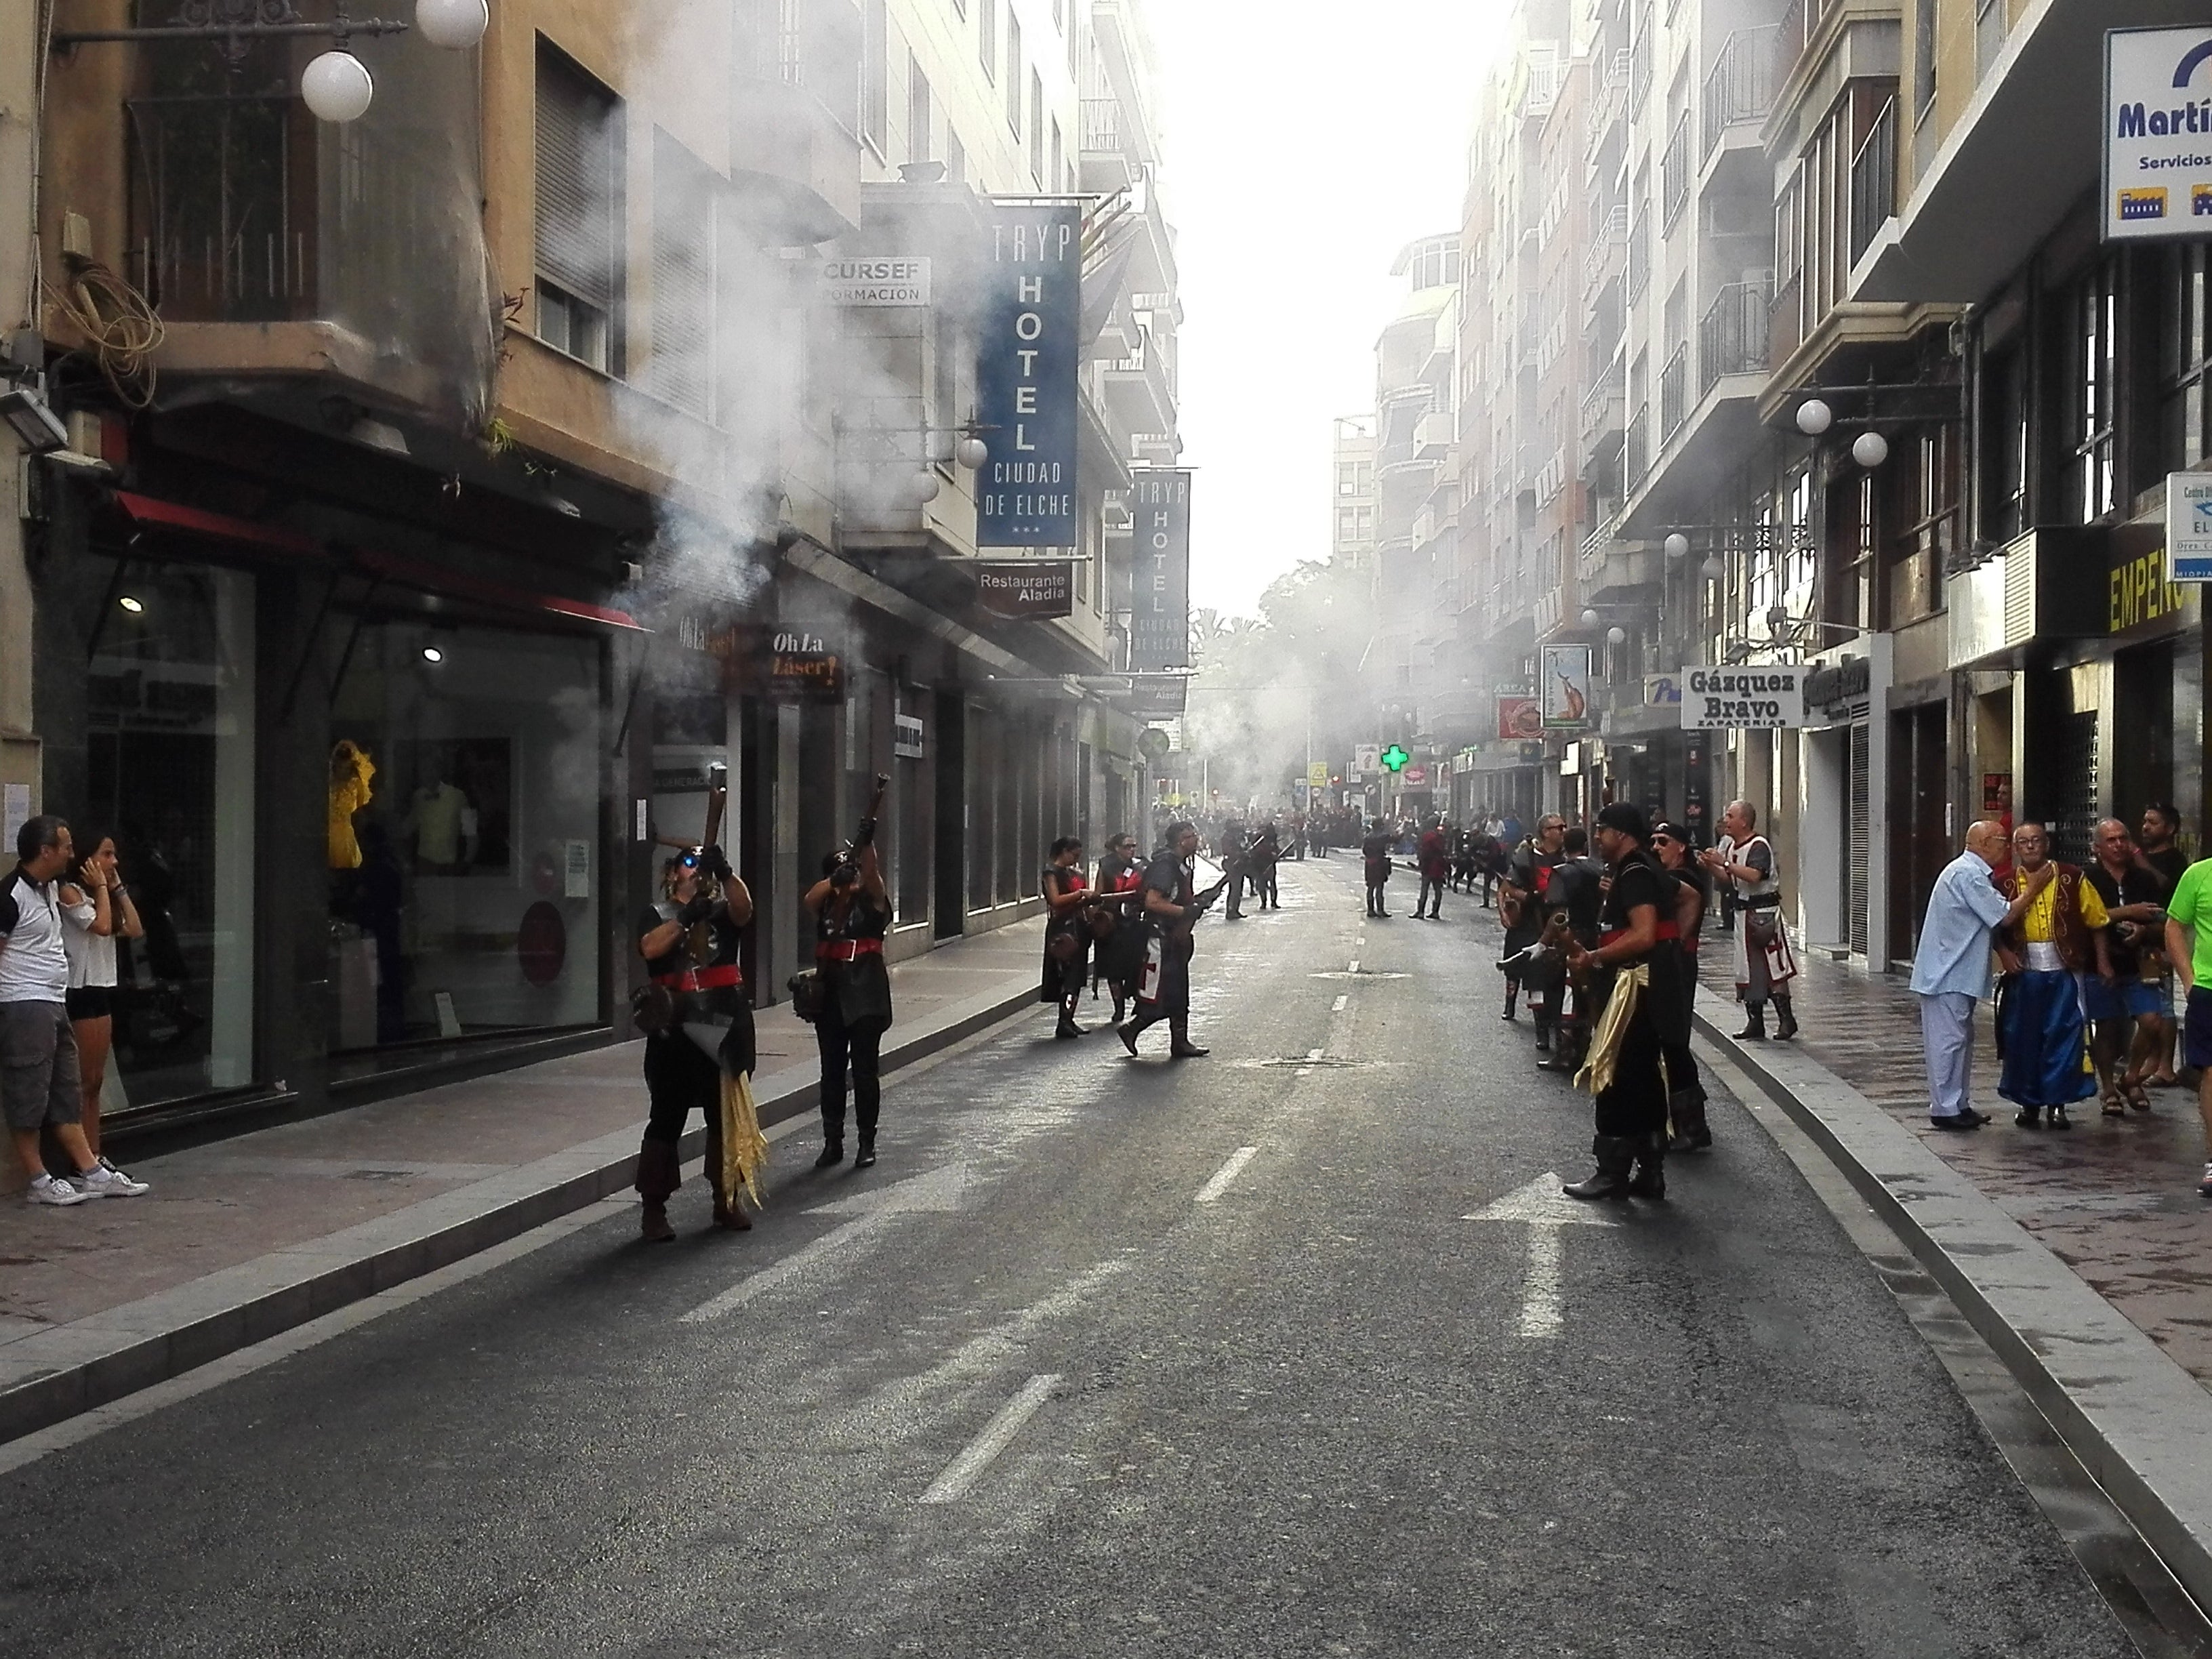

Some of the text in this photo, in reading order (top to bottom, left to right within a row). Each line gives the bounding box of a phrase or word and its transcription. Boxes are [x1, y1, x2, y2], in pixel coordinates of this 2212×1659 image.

[2118, 98, 2212, 138] Martí
[2139, 153, 2212, 169] Servicios
[992, 224, 1071, 262] TRYP
[823, 263, 918, 279] CURSEF
[823, 289, 920, 300] ORMACION
[1016, 276, 1042, 451] HOTEL
[995, 462, 1061, 483] CIUDAD
[1140, 482, 1185, 503] TRYP
[986, 495, 1069, 515] DE ELCHE
[2194, 521, 2212, 533] EL
[1153, 512, 1168, 612] HOTEL
[981, 575, 1065, 588] Restaurante
[1019, 588, 1065, 601] Aladia
[773, 633, 823, 652] Oh La
[1689, 670, 1795, 697] Gázquez
[1704, 697, 1780, 718] Bravo
